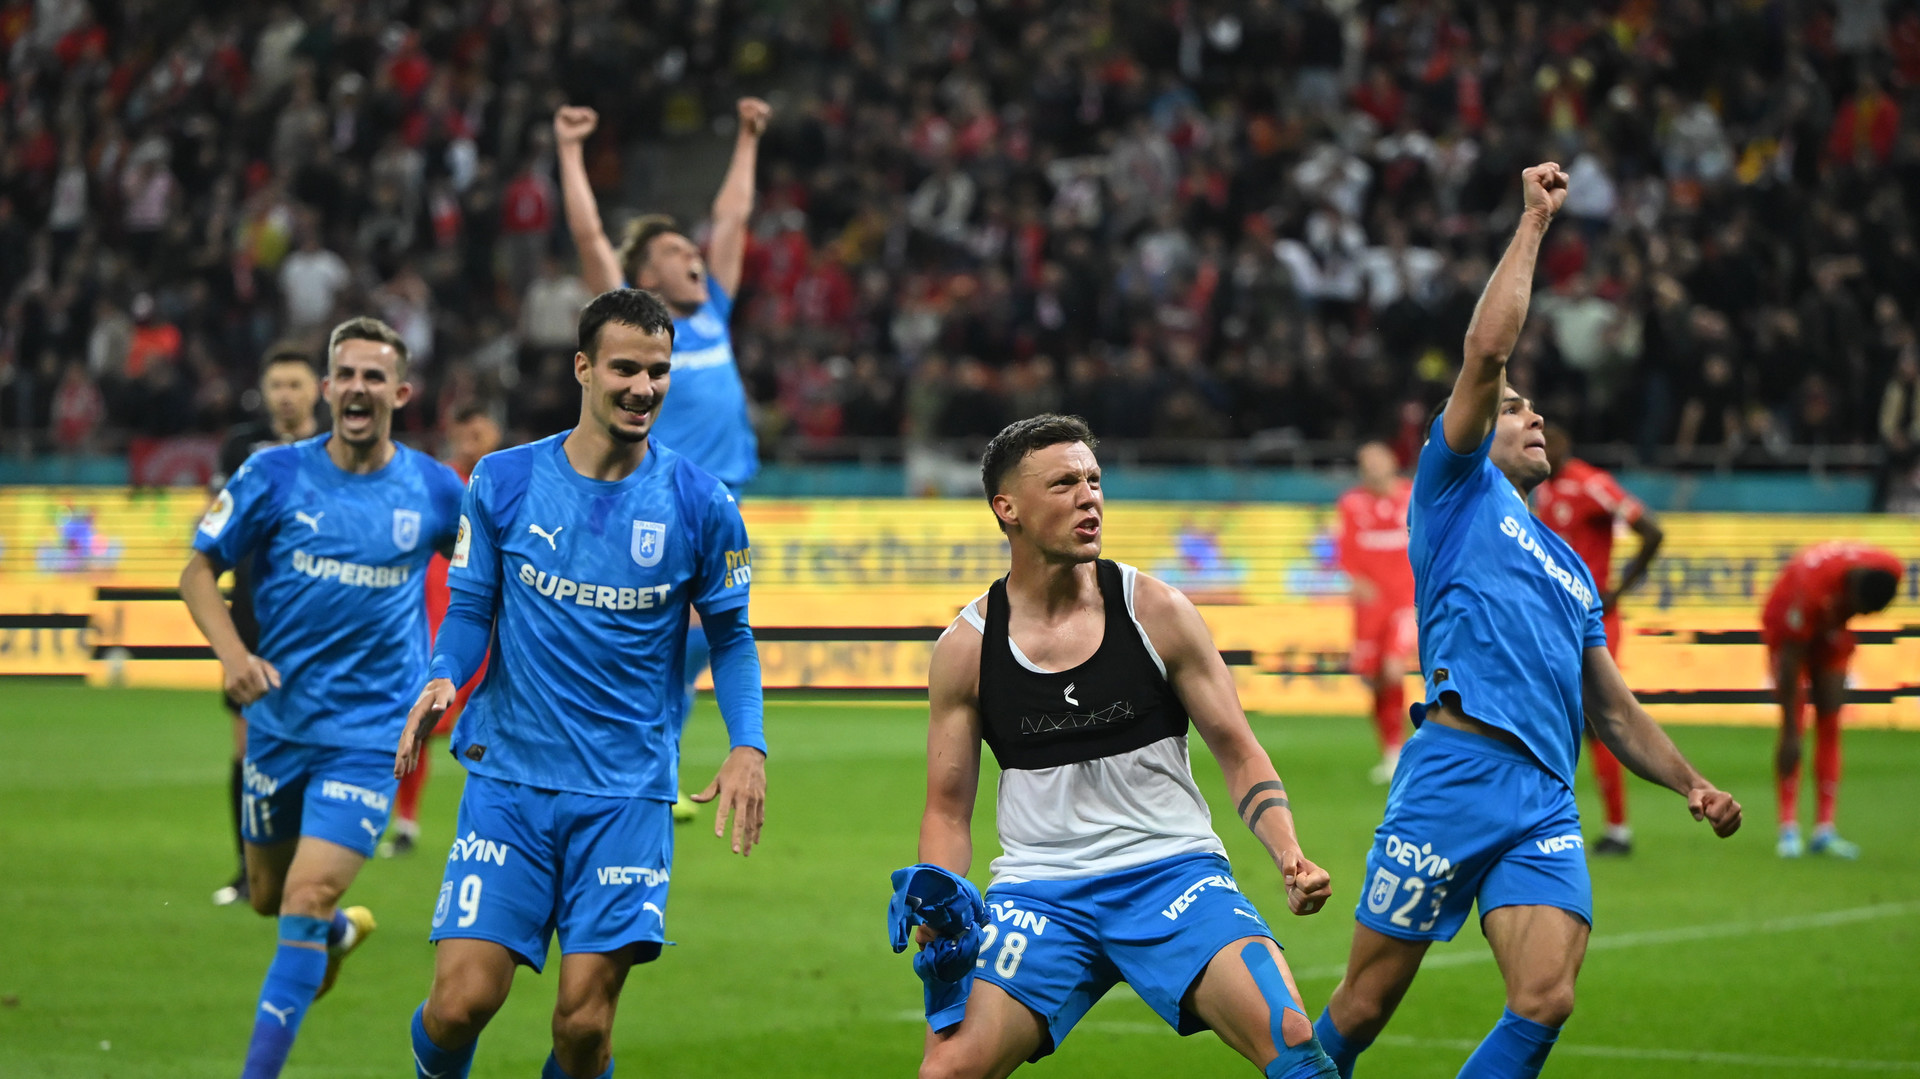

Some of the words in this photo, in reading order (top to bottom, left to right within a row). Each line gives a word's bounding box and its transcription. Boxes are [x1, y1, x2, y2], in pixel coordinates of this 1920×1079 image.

[292, 548, 411, 588] SUPERBET
[519, 563, 671, 610] SUPERBET
[1499, 515, 1594, 611] SUPERBE
[457, 873, 483, 928] 9
[1389, 876, 1447, 932] 23
[975, 923, 1028, 979] 28
